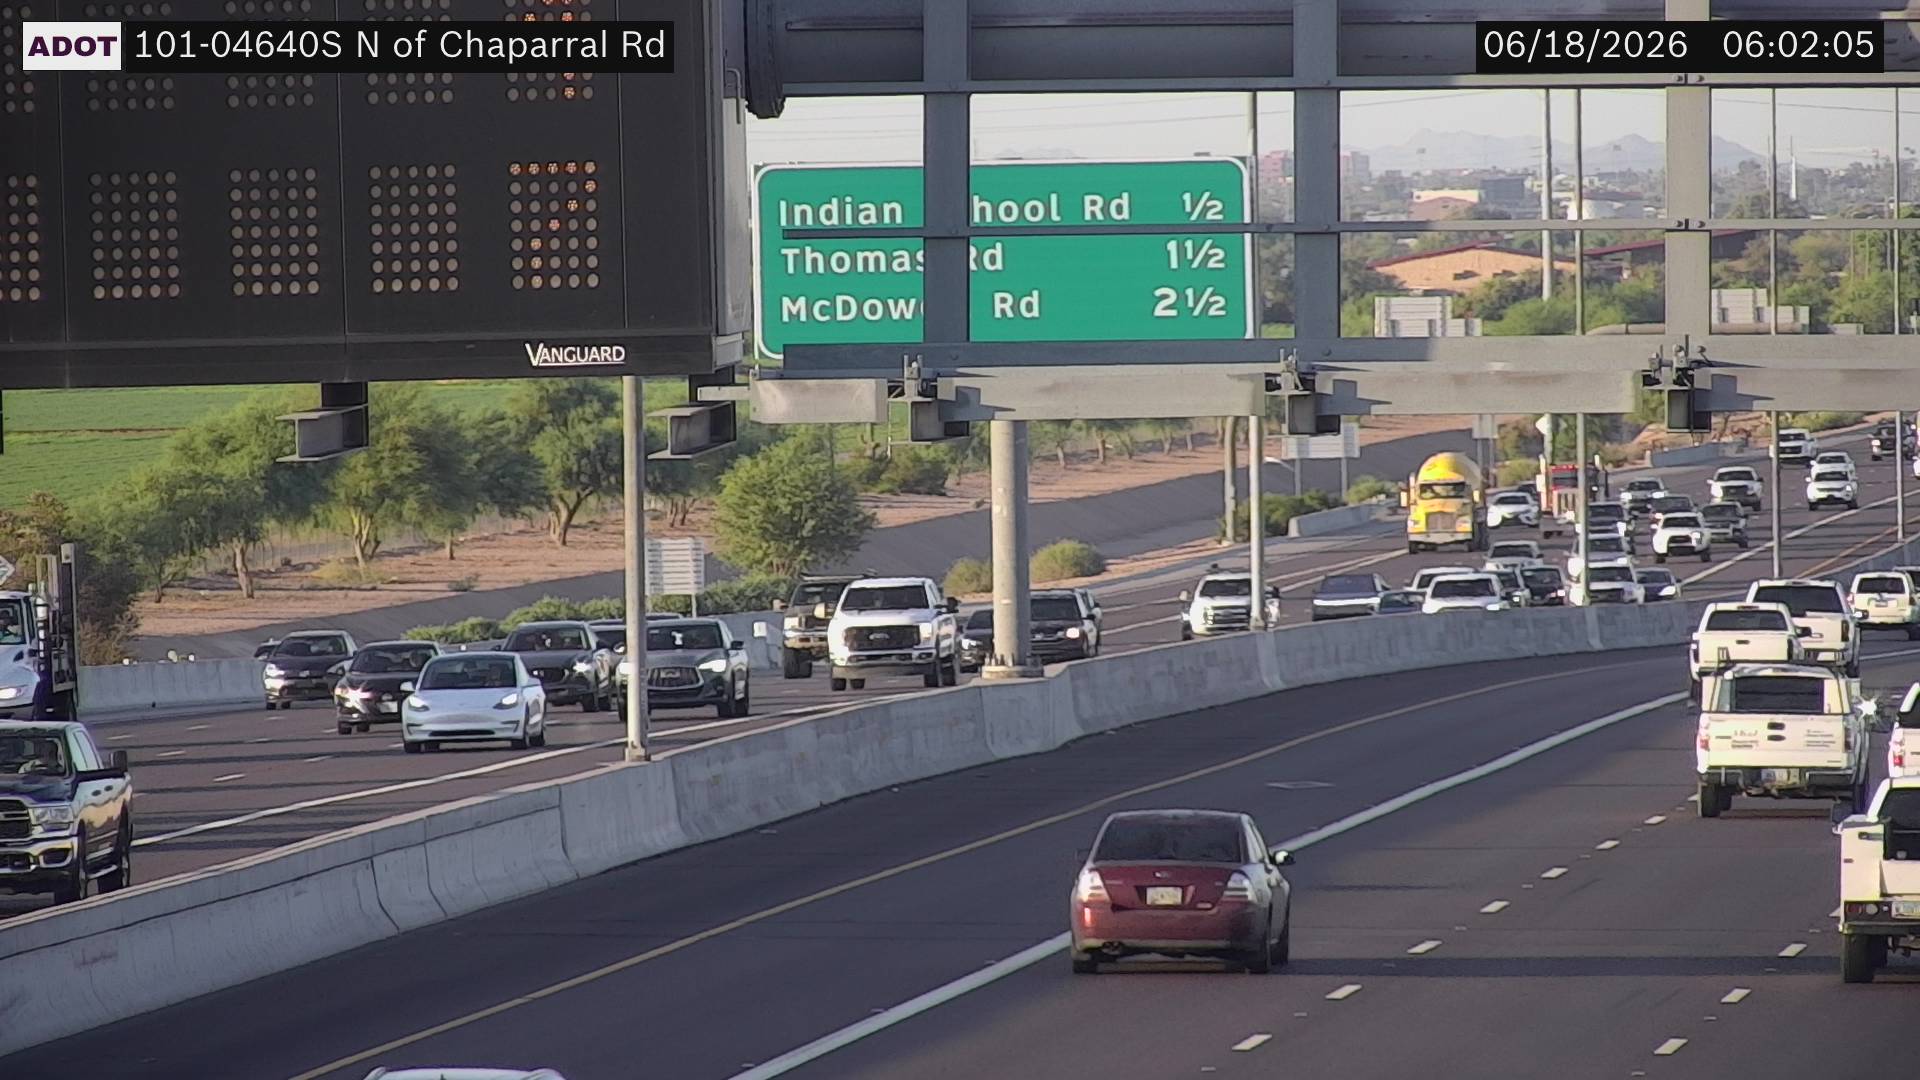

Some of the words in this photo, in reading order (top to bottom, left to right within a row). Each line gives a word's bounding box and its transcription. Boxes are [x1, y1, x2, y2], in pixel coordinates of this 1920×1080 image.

[779, 196, 903, 227] Indian
[972, 193, 1061, 223] hool
[1083, 192, 1130, 221] Rd
[781, 294, 923, 322] McDow
[993, 290, 1040, 318] Rd
